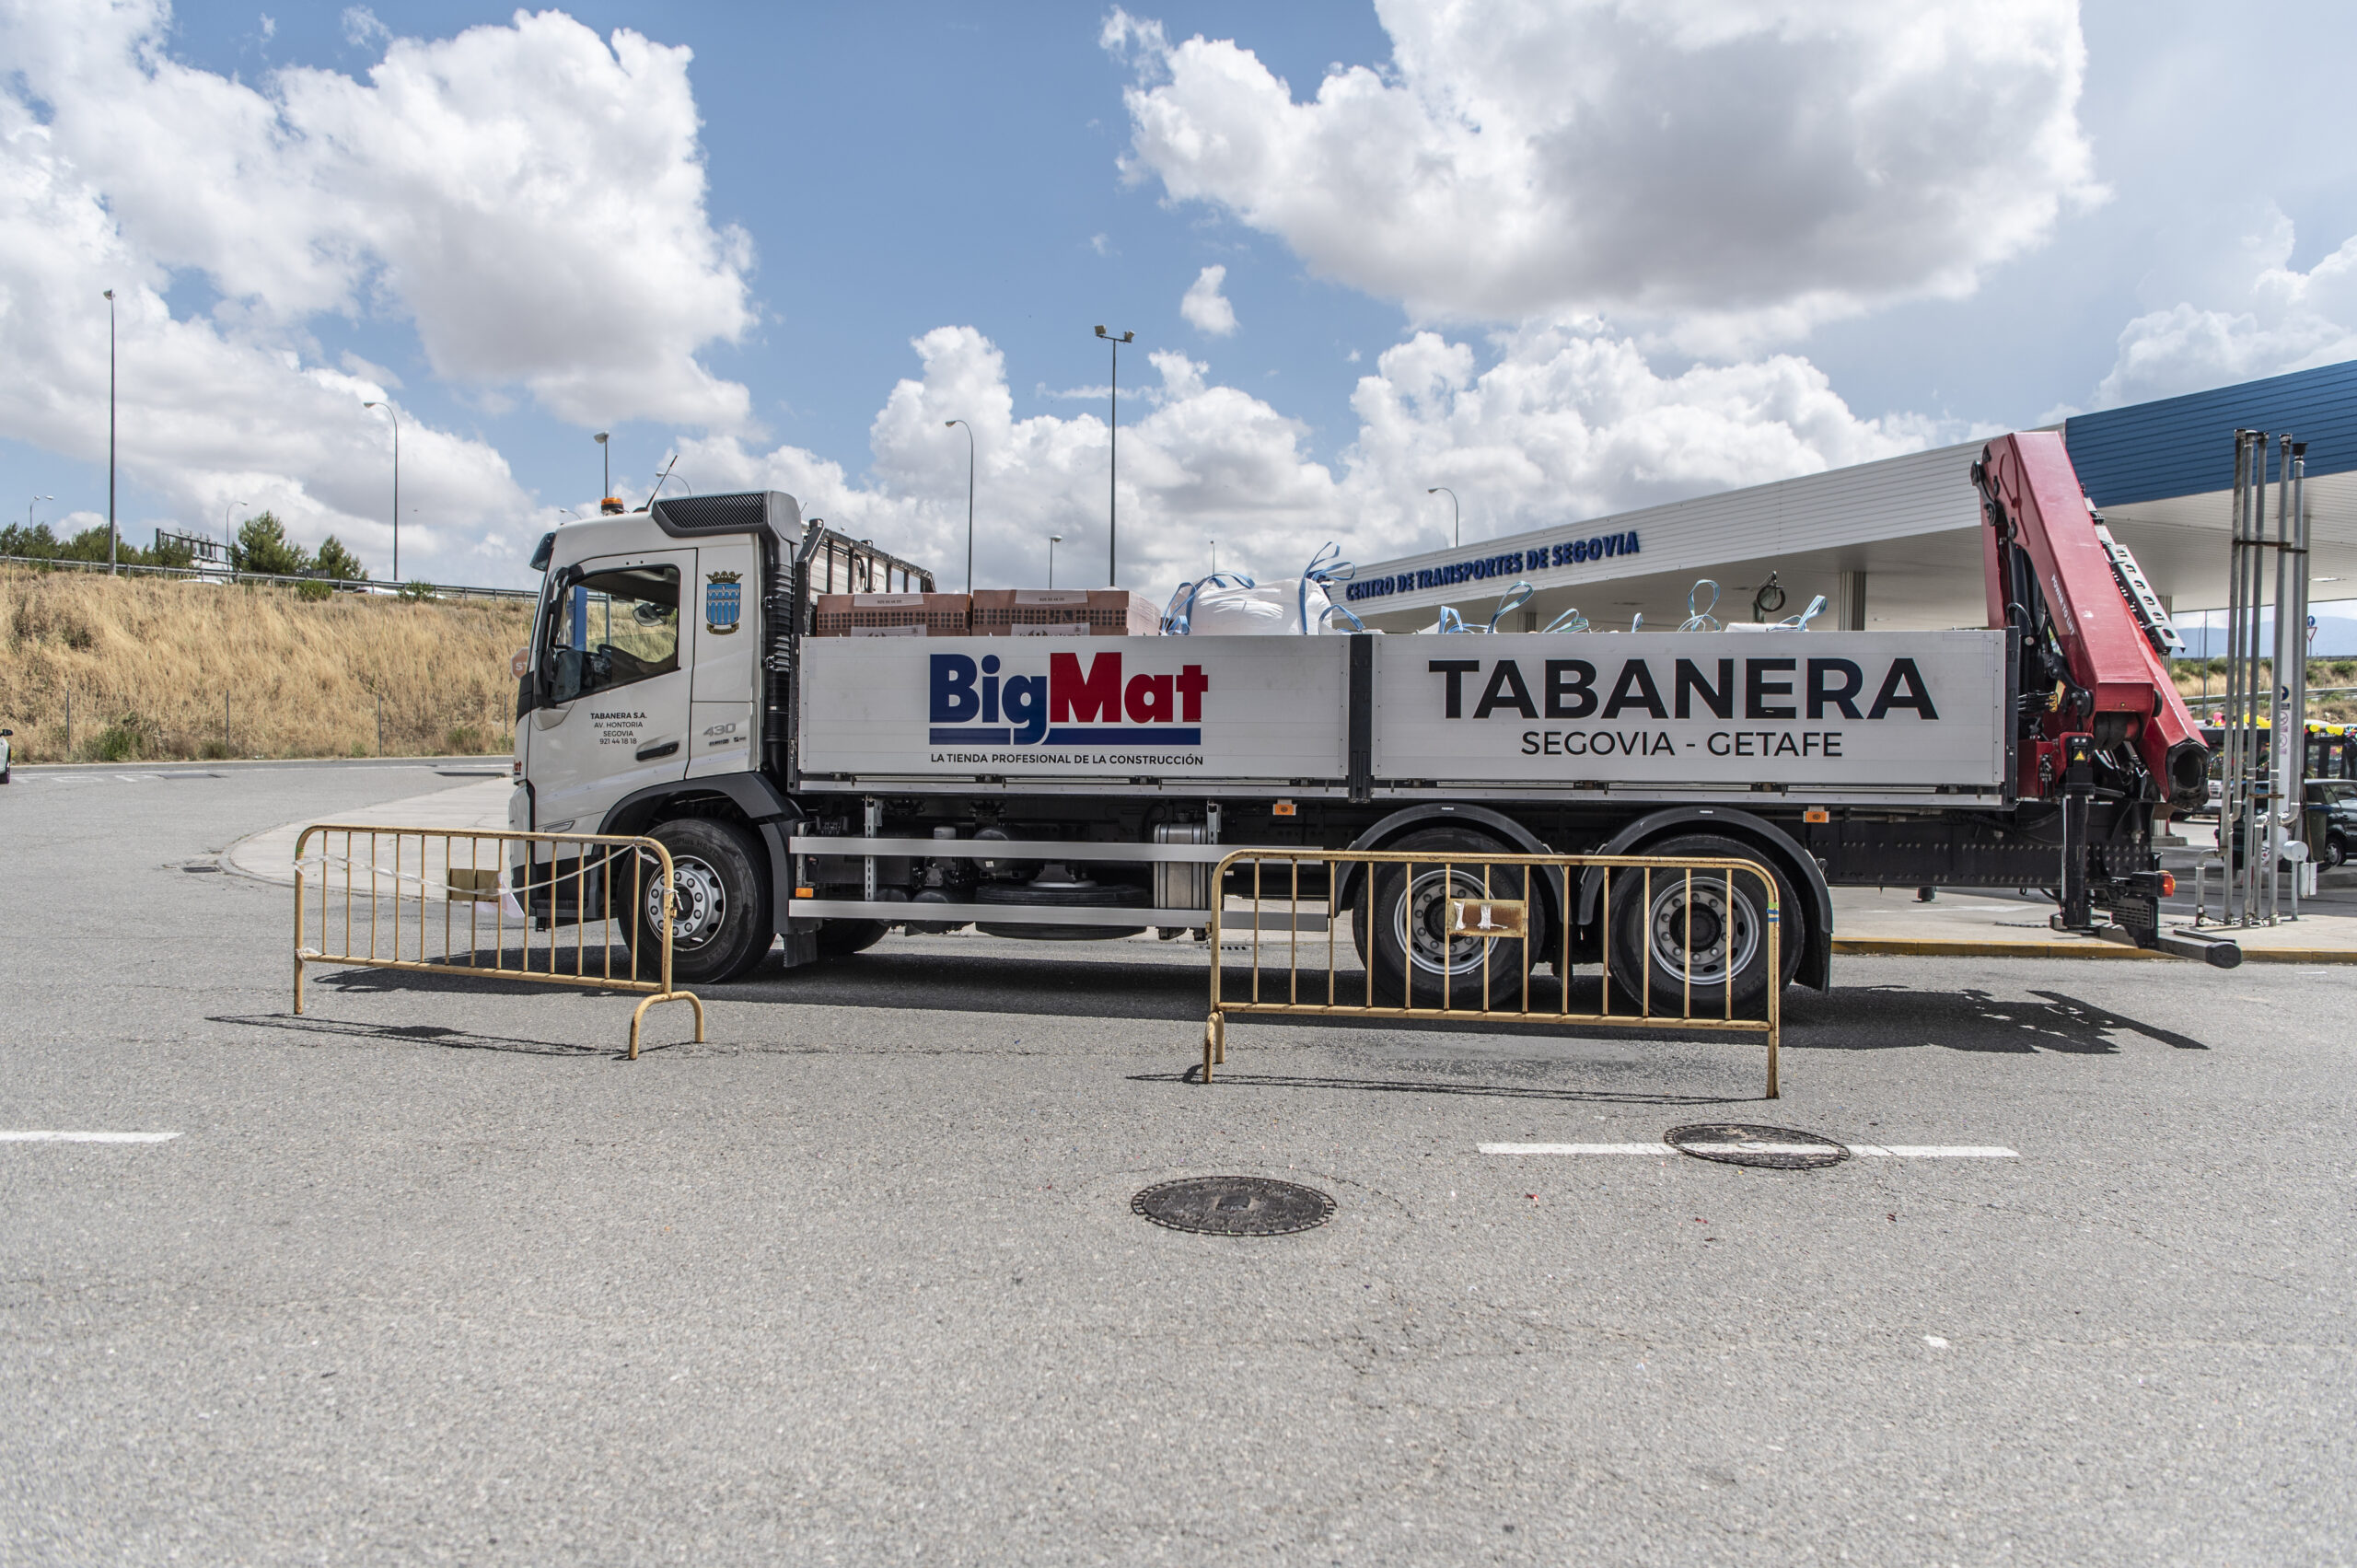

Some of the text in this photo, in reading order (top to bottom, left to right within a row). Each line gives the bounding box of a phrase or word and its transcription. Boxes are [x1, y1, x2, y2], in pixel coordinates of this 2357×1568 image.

[1346, 531, 1640, 600] CENTRO DE TRANSPORTES DE SEGOVIA
[2051, 575, 2074, 636] POWER TO LIFT
[929, 652, 1209, 745] BigMat
[1428, 658, 1940, 721] TABANERA
[702, 723, 737, 737] 430
[931, 753, 1203, 765] LA TIENDA PROFESIONAL DE LA CONSTRUCCIÓN
[1521, 730, 1676, 757] SEGOVIA
[1707, 730, 1842, 757] GETAFE
